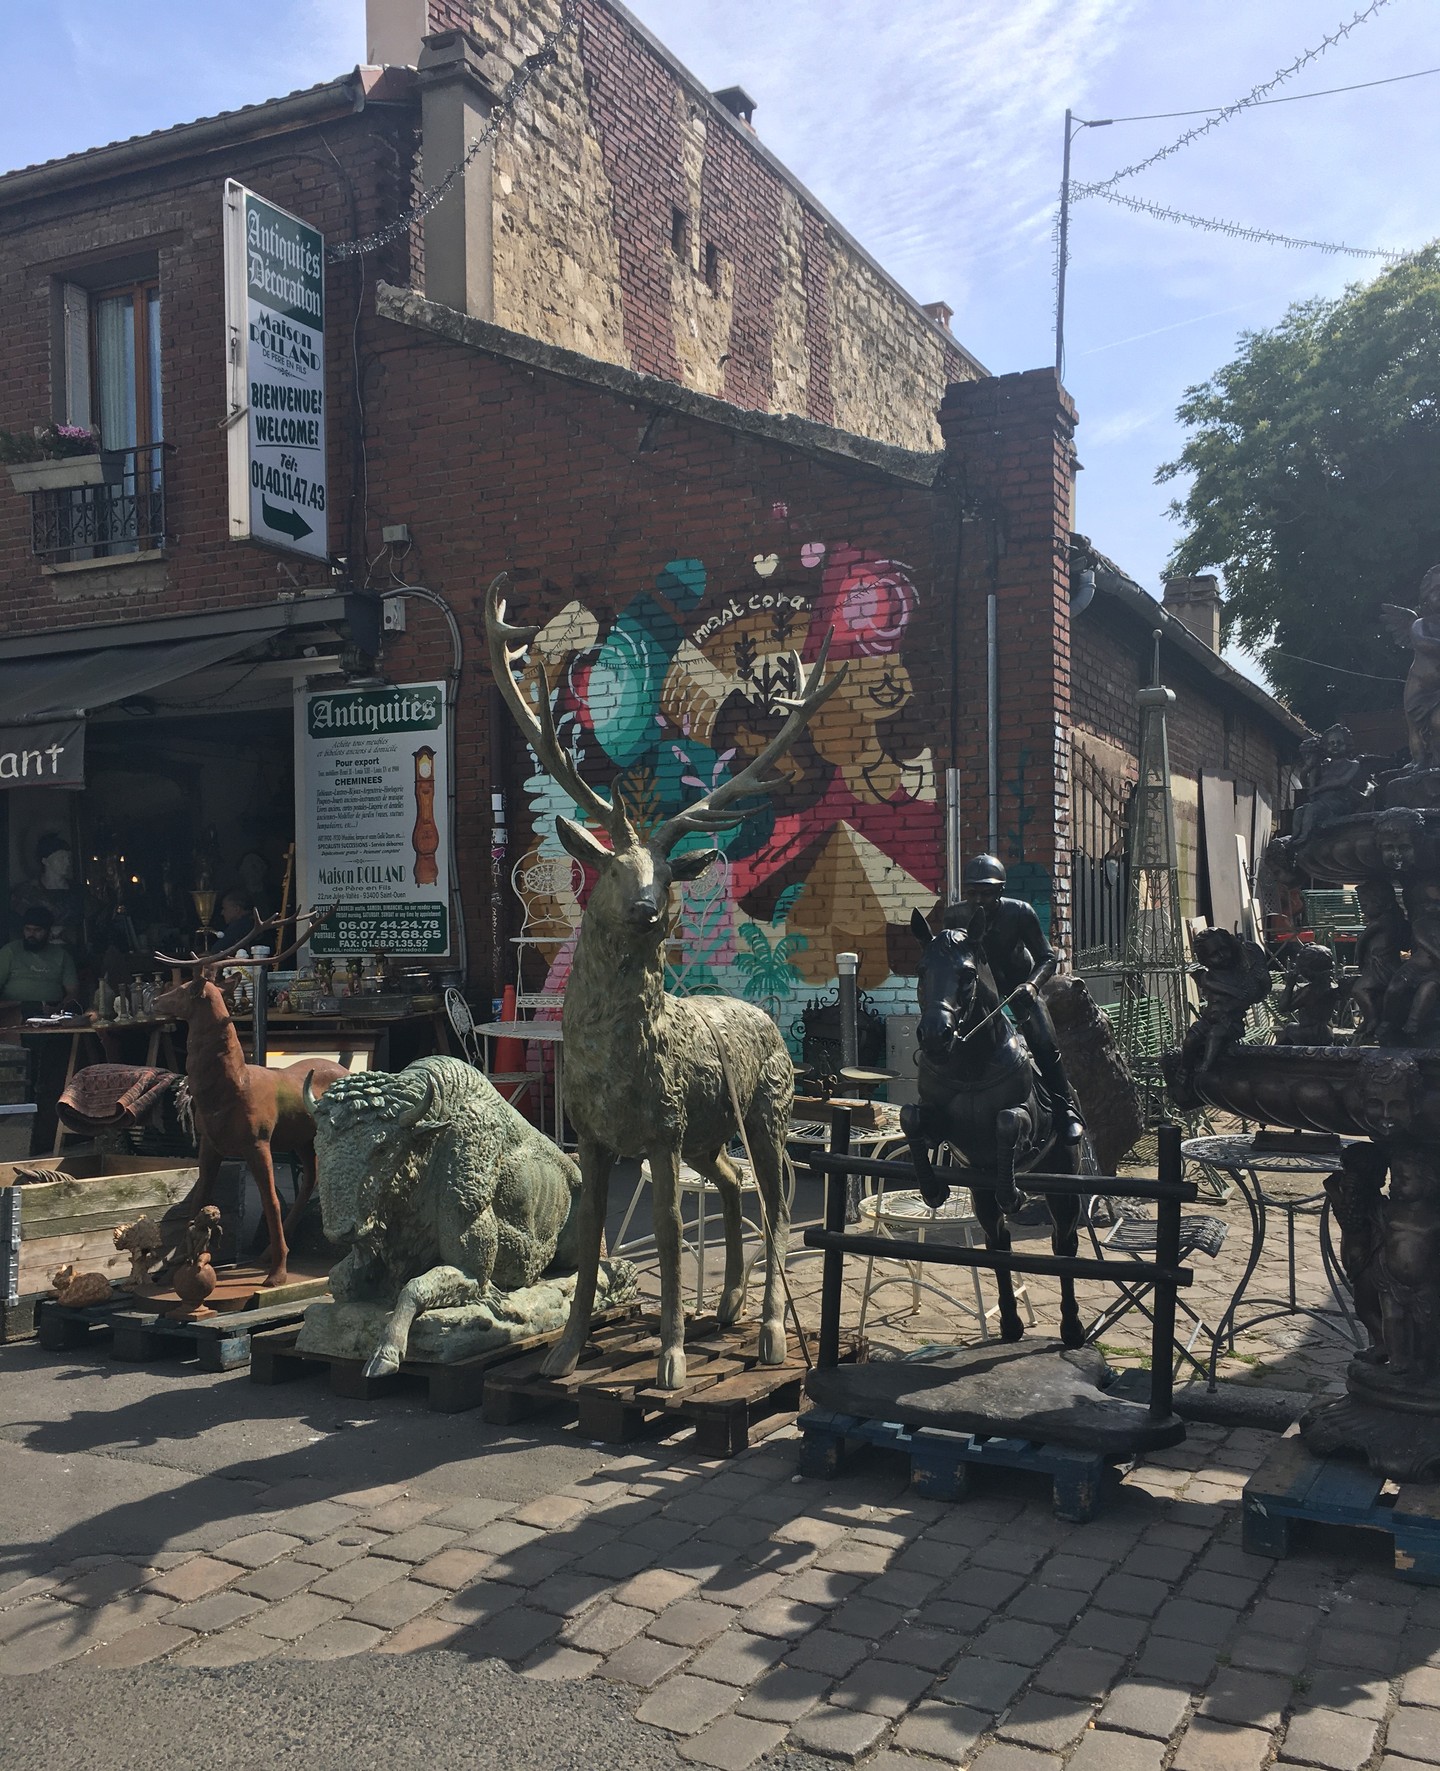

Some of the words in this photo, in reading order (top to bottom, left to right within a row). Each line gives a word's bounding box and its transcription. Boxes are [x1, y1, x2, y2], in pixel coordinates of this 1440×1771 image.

[247, 208, 321, 280] Antiquités
[248, 248, 321, 318] Décoration
[259, 309, 312, 350] Maison
[249, 322, 321, 371] ROLLAND
[262, 348, 270, 359] DE
[271, 352, 285, 366] PERE
[286, 359, 294, 370] EN
[295, 364, 307, 375] FILS
[251, 382, 322, 415] BIENVENUE!
[255, 415, 319, 446] WELCOME!
[280, 453, 298, 473] Tél:
[251, 459, 326, 512] 01.40.11.47.43
[312, 693, 437, 731] Antiquités
[0, 743, 65, 778] ant
[335, 759, 353, 767] Pour
[354, 757, 380, 767] export
[334, 775, 383, 786] CHEMINEES
[317, 866, 354, 884] Maison
[357, 865, 406, 884] ROLLAND
[339, 921, 377, 930] 06.07
[380, 920, 439, 929] 44.24.78
[339, 930, 442, 939] 06.07.53.68.65
[339, 940, 360, 948] FAX:
[361, 939, 429, 948] 01.58.61.35.52
